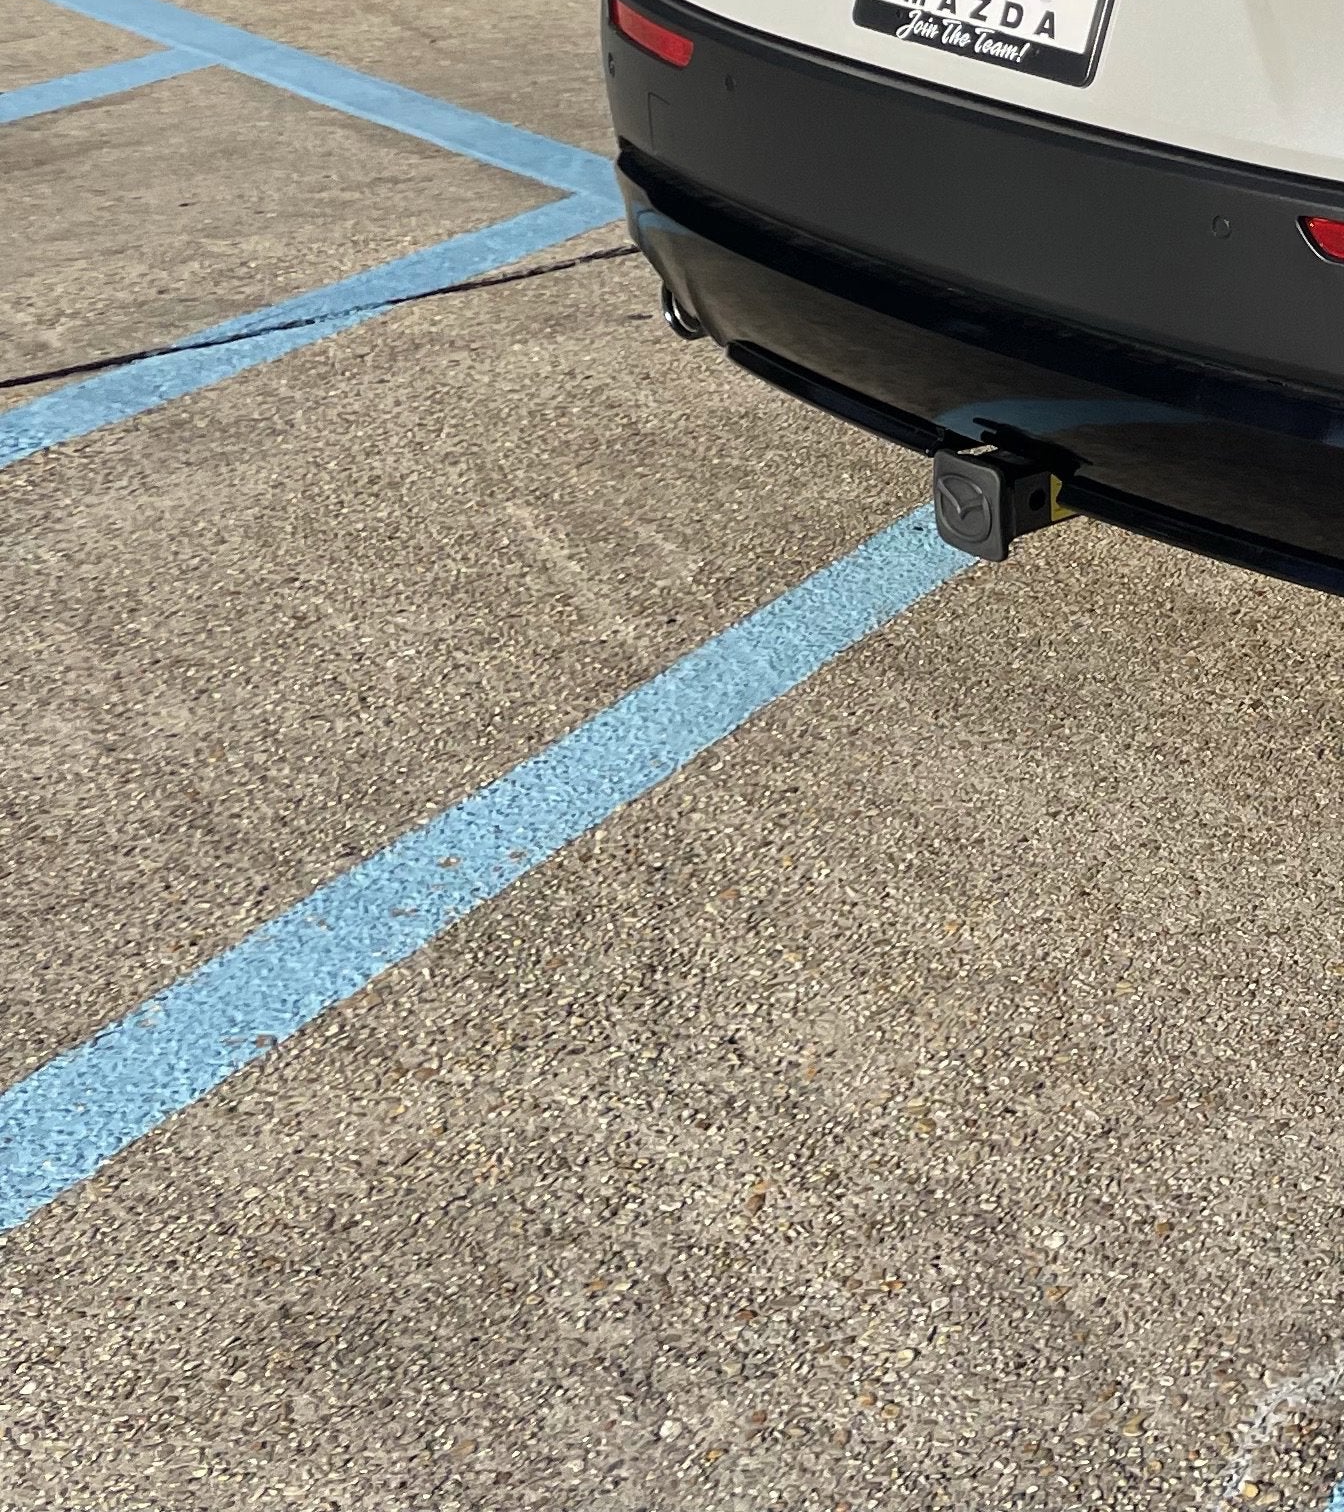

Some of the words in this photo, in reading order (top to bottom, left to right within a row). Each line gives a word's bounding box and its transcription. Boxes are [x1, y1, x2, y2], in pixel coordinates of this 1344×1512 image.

[896, 9, 939, 40] Join
[941, 18, 971, 47] The
[974, 28, 1031, 62] Team!
